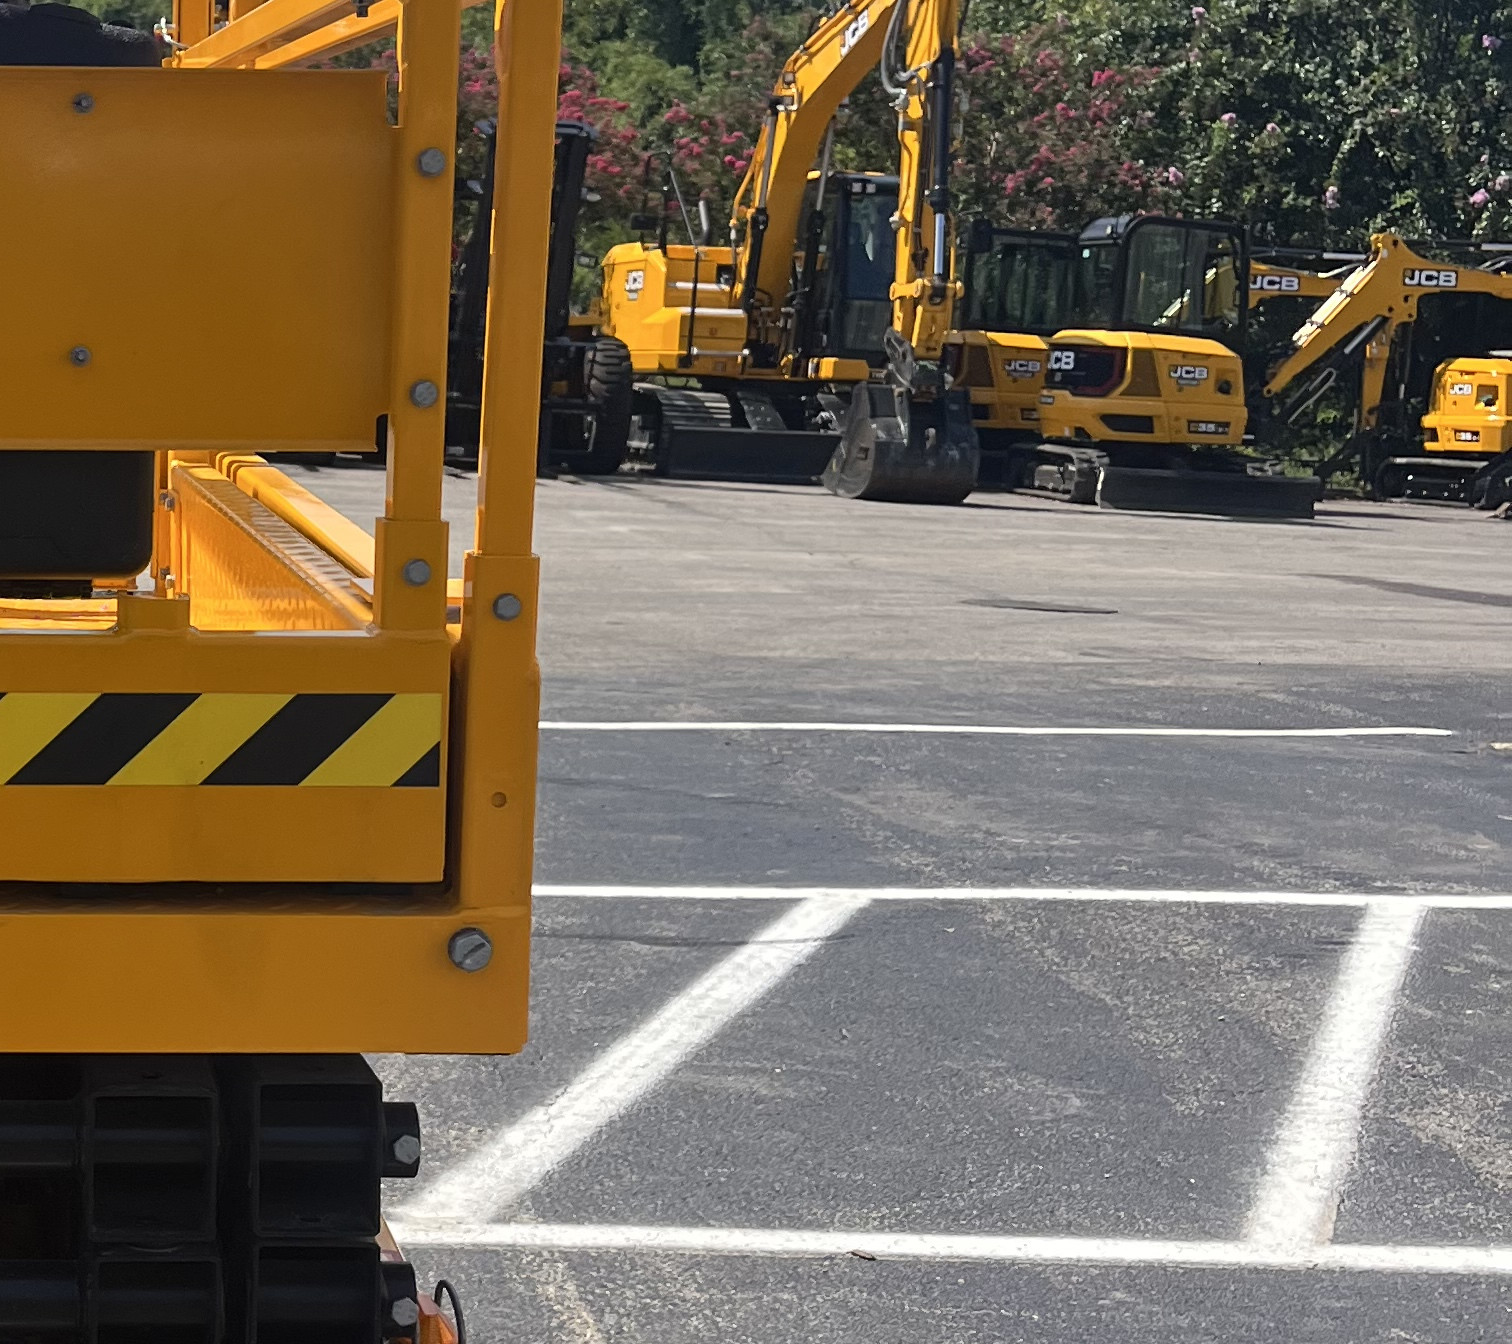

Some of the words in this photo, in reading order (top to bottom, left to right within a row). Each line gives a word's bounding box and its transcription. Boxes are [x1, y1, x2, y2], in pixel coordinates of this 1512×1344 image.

[1404, 271, 1458, 287] JCB
[1004, 360, 1041, 372] JCB
[1170, 365, 1208, 379] JCB
